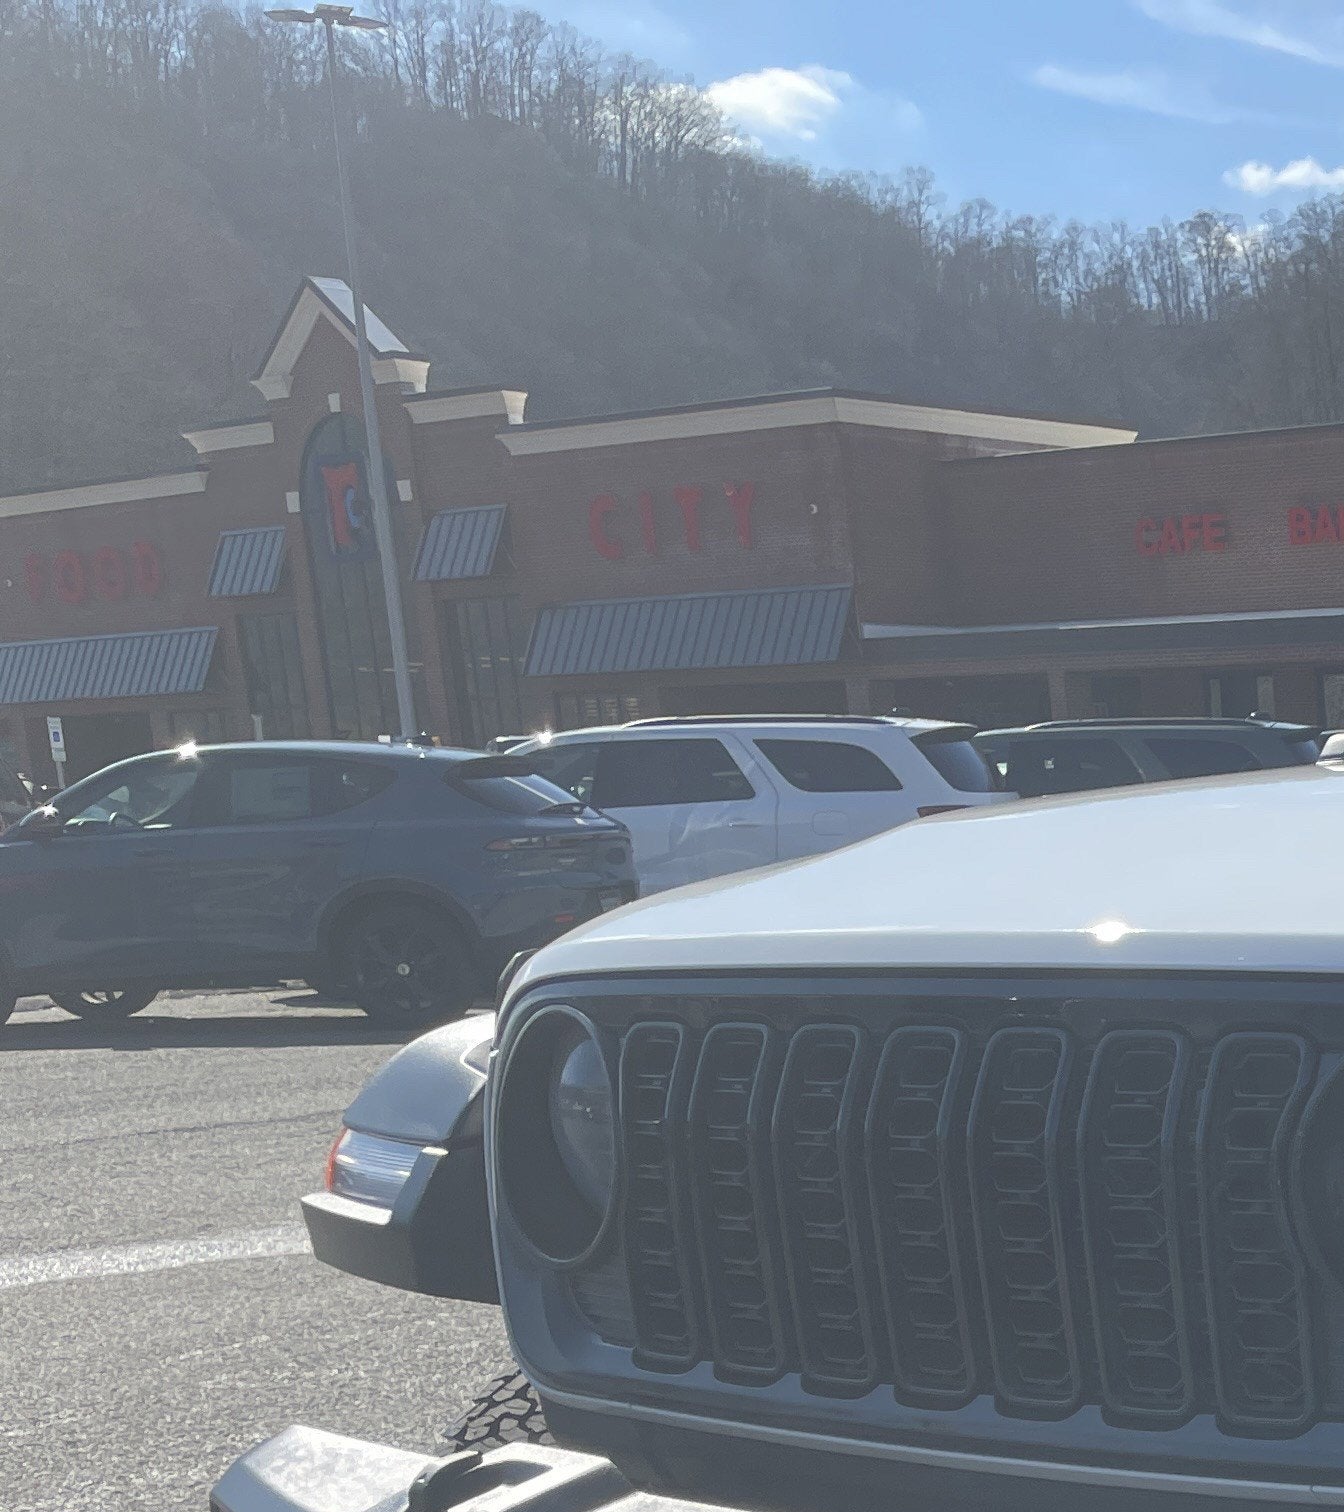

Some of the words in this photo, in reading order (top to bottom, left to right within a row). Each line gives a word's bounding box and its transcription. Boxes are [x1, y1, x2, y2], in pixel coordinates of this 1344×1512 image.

[23, 540, 161, 603] FOOD
[588, 480, 755, 560] CITY
[1135, 512, 1227, 556] CAFE
